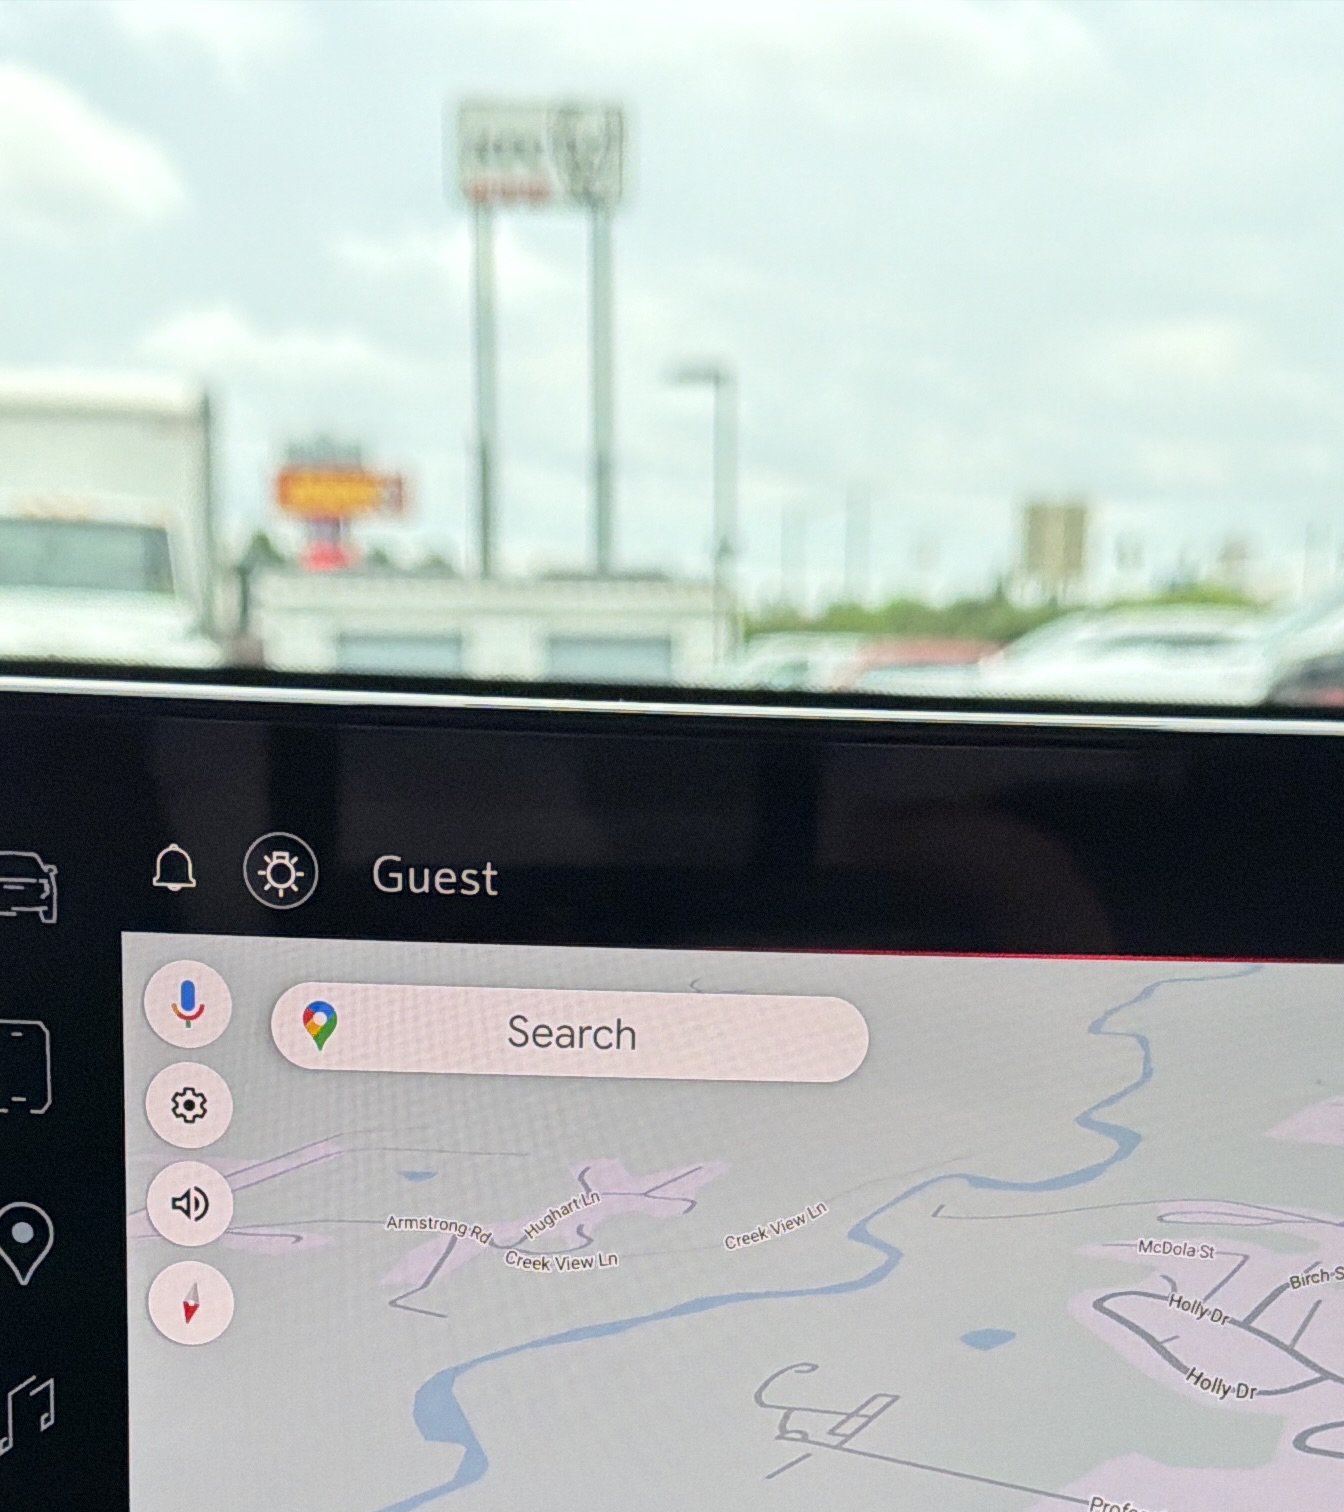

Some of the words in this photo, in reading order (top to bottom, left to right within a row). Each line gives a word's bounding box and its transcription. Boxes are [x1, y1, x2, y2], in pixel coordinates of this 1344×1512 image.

[372, 854, 499, 897] Guest
[508, 1014, 636, 1050] Search
[386, 1214, 468, 1238] Armstrong
[470, 1225, 492, 1244] Rd
[523, 1200, 580, 1240] Hughart
[579, 1190, 602, 1210] Ln
[724, 1228, 768, 1250] Creek
[768, 1213, 806, 1236] View
[806, 1200, 828, 1221] Ln
[505, 1251, 551, 1272] Creek
[555, 1253, 595, 1271] View
[598, 1250, 618, 1267] Ln
[1137, 1239, 1196, 1257] McDola
[1197, 1243, 1215, 1259] St
[1289, 1269, 1329, 1291] Birch
[1169, 1293, 1212, 1319] Holly
[1211, 1307, 1230, 1325] Dr
[1185, 1366, 1231, 1399] Holly
[1235, 1382, 1257, 1400] Dr
